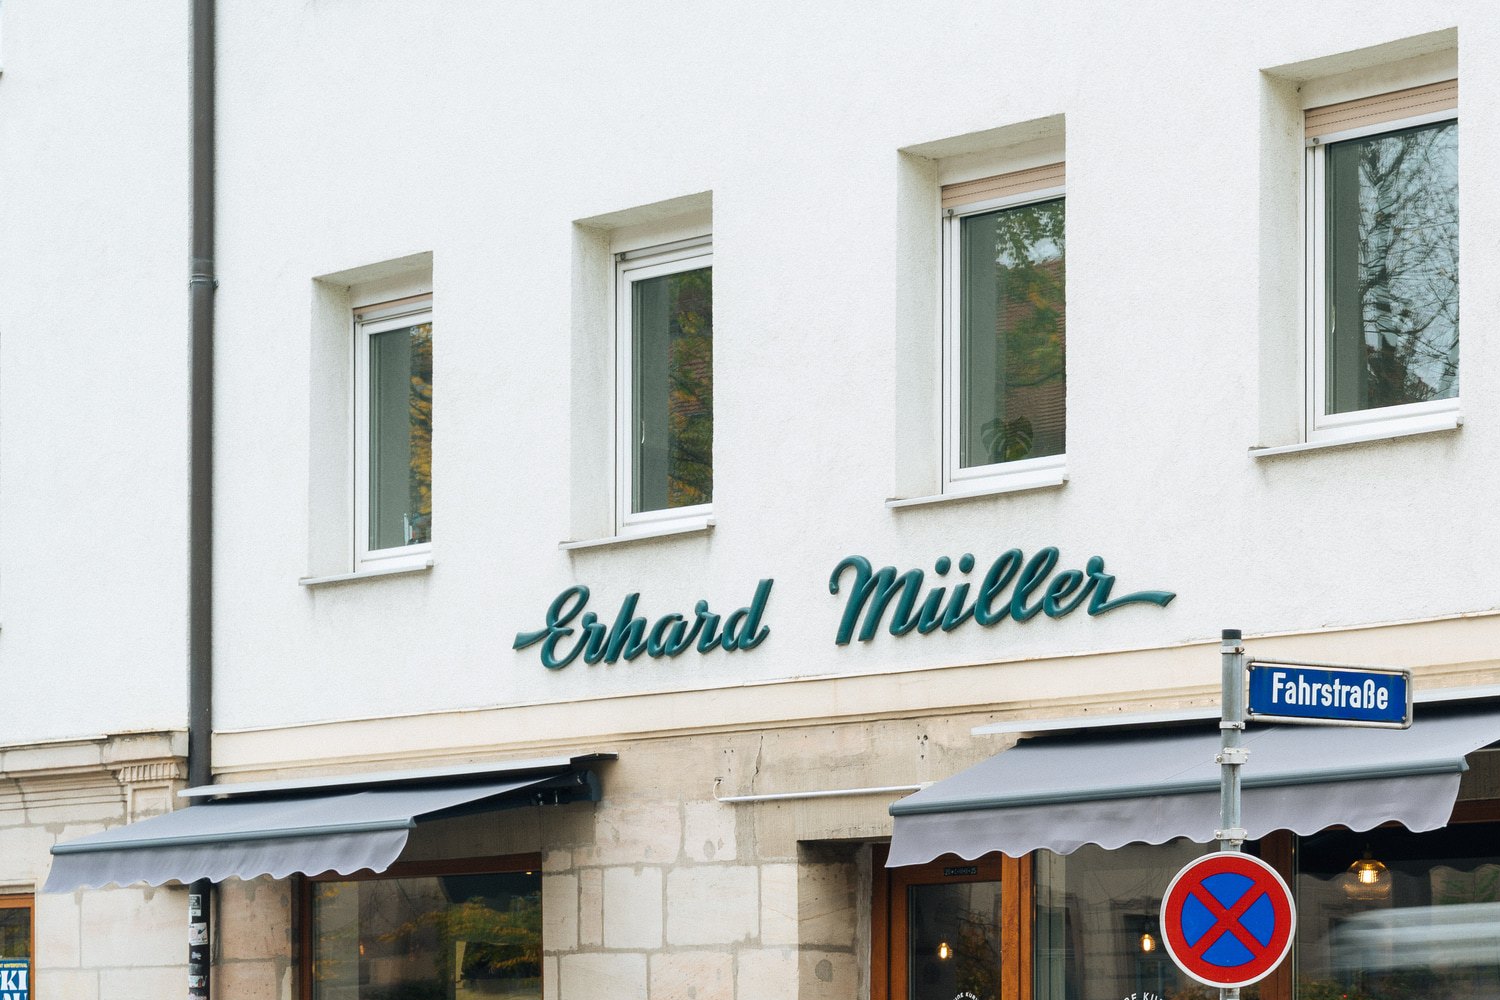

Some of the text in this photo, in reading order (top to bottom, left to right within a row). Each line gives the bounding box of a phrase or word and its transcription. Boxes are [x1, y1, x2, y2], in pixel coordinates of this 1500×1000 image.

[511, 546, 1177, 670] Erhard Müller
[1272, 671, 1389, 710] Fahrstraße
[0, 970, 28, 990] KI
